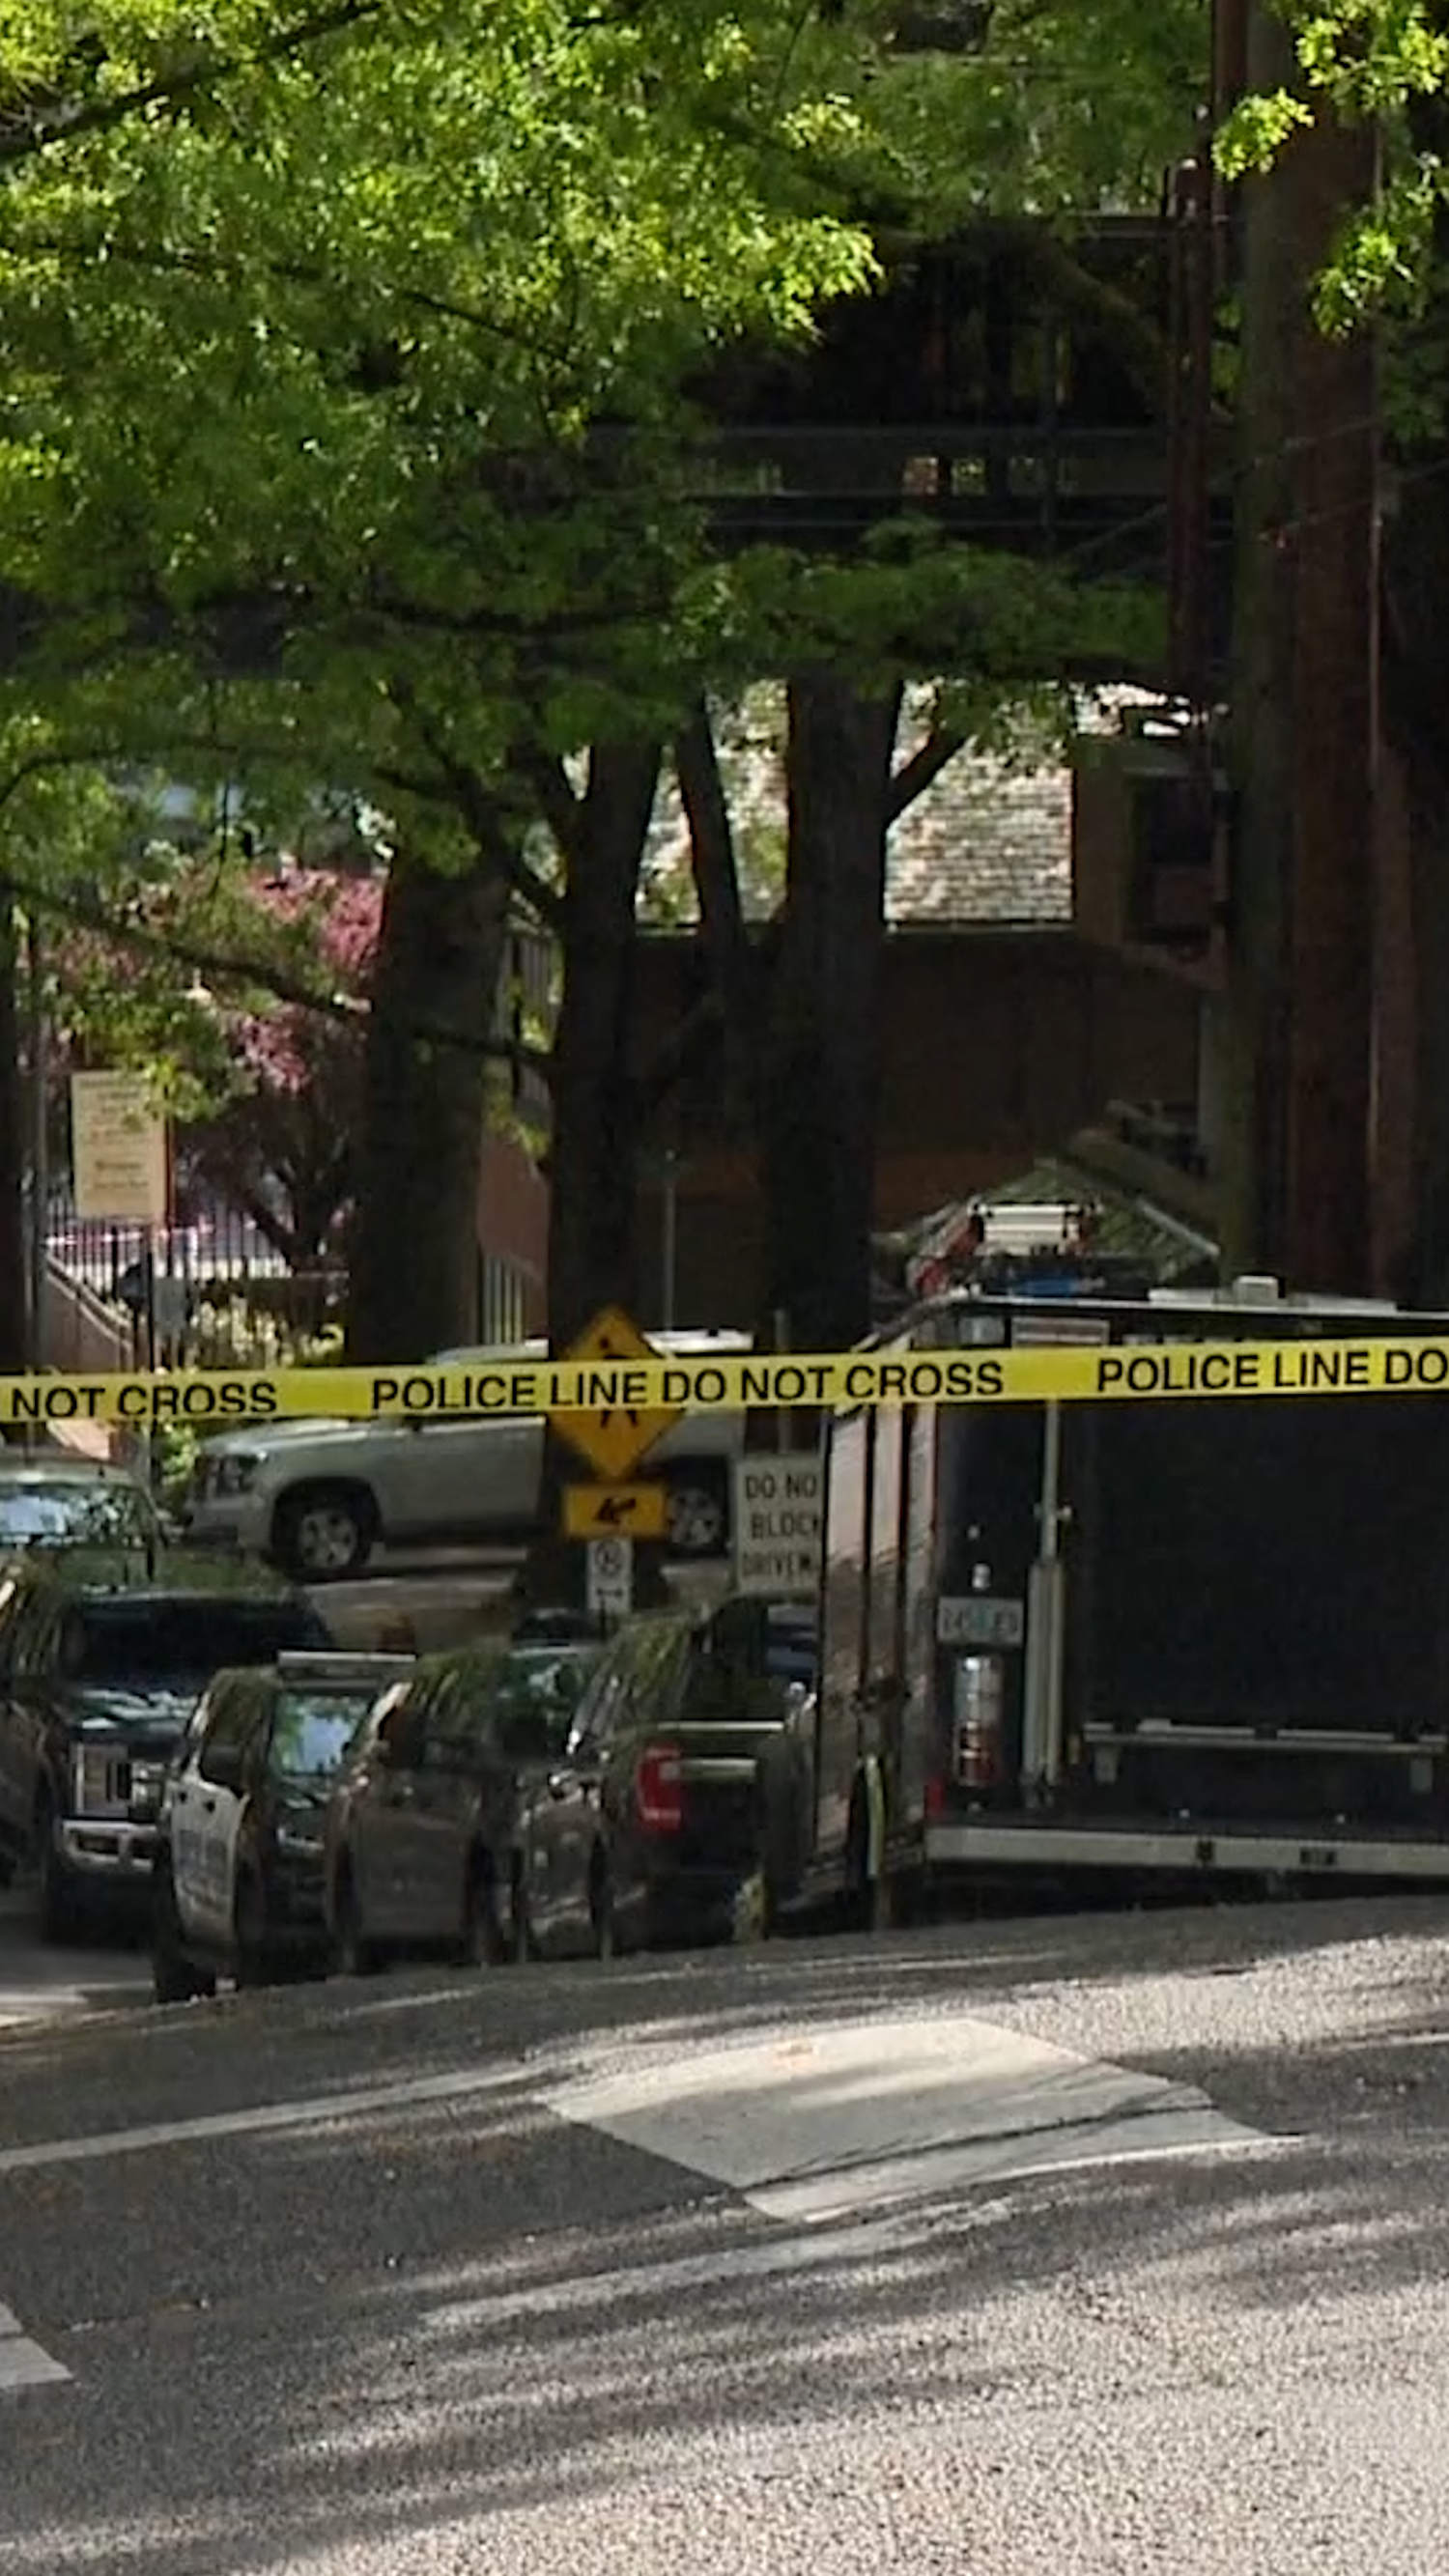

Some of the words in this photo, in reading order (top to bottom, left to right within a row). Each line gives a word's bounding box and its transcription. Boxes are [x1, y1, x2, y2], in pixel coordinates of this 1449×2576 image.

[372, 1375, 535, 1409] POLICE
[551, 1372, 647, 1405] LINE
[663, 1369, 725, 1402] DO
[741, 1366, 834, 1401] NOT
[845, 1361, 1004, 1398] CROSS
[1096, 1354, 1260, 1392] POLICE
[1274, 1350, 1370, 1387] LINE
[1384, 1347, 1447, 1384] DO
[11, 1386, 105, 1418] NOT
[116, 1382, 278, 1416] CROSS
[745, 1473, 776, 1499] DO
[785, 1472, 818, 1499] NO
